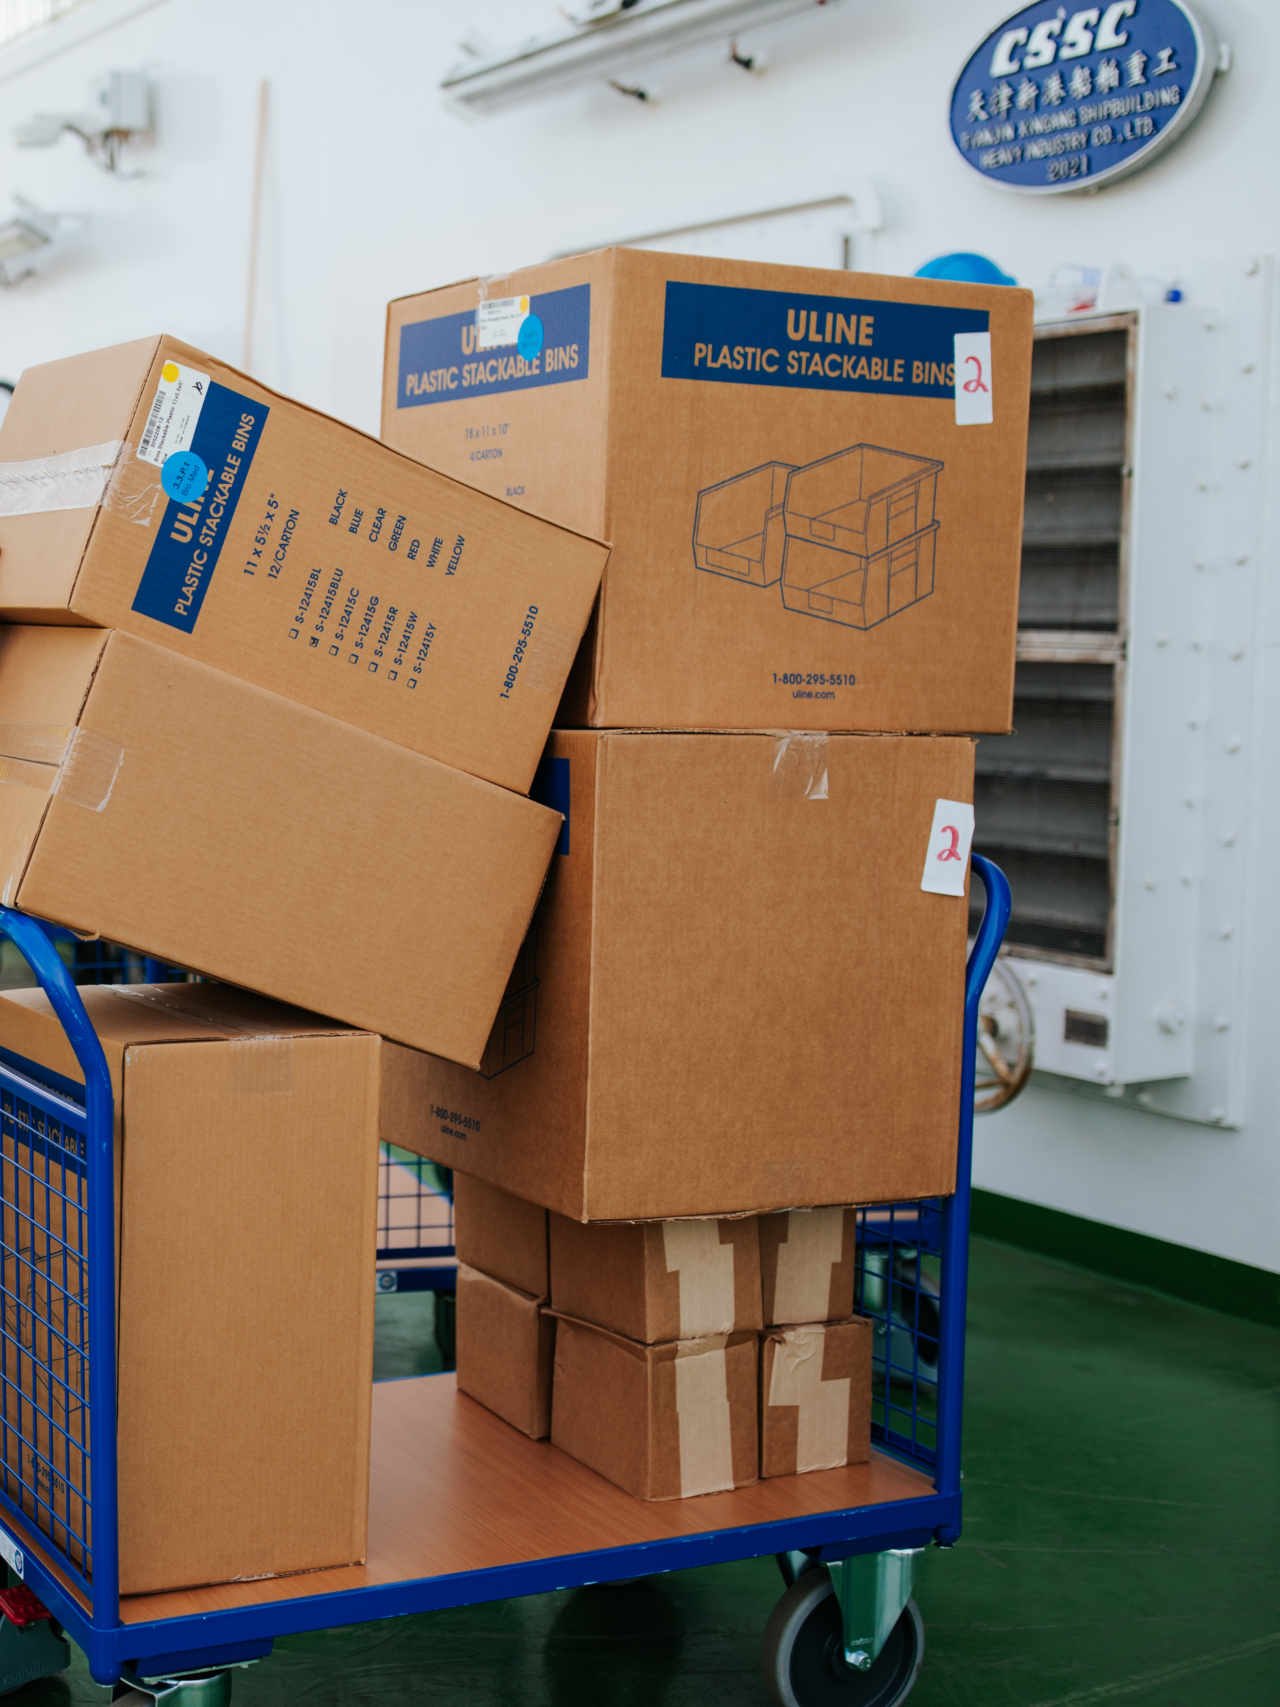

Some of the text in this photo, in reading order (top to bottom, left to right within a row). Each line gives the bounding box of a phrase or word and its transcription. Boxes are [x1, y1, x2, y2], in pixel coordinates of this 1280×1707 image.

[989, 0, 1137, 78] CSSC
[960, 84, 1181, 151] TIANJIN XINGANG SHIPBUILDING
[979, 142, 1024, 170] HEAVY
[1026, 130, 1091, 160] INDUSTRY
[1046, 154, 1090, 182] 2021
[786, 308, 875, 347] ULINE
[406, 343, 580, 397] PLASTIC STACKABLE BINS
[693, 342, 956, 388] PLASTIC STACKABLE BINS
[963, 356, 990, 393] 2
[169, 468, 215, 544] ULI
[174, 413, 255, 616] PLASTIC STACKABLE BINS
[506, 485, 526, 497] BLACK
[243, 560, 258, 576] 11
[252, 547, 263, 558] x
[265, 511, 276, 522] x
[267, 508, 300, 579] 12/CARTON
[294, 488, 348, 624] S-12415BL BLACK
[315, 508, 364, 632] S-12415BLU BLUE
[335, 507, 387, 641] S-12415C CLEAR
[354, 514, 407, 649] S-12415G GREEN
[374, 538, 421, 657] S-12415R RED
[393, 536, 444, 666] S-12415W WHITE
[413, 534, 466, 674] S-12415Y YELLOW
[499, 604, 540, 701] 1-800-295-5510
[772, 672, 856, 686] 1-800-295-5510
[792, 689, 836, 699] uline.com
[936, 825, 963, 862] 2
[430, 1104, 480, 1132] 1-800-295-5510
